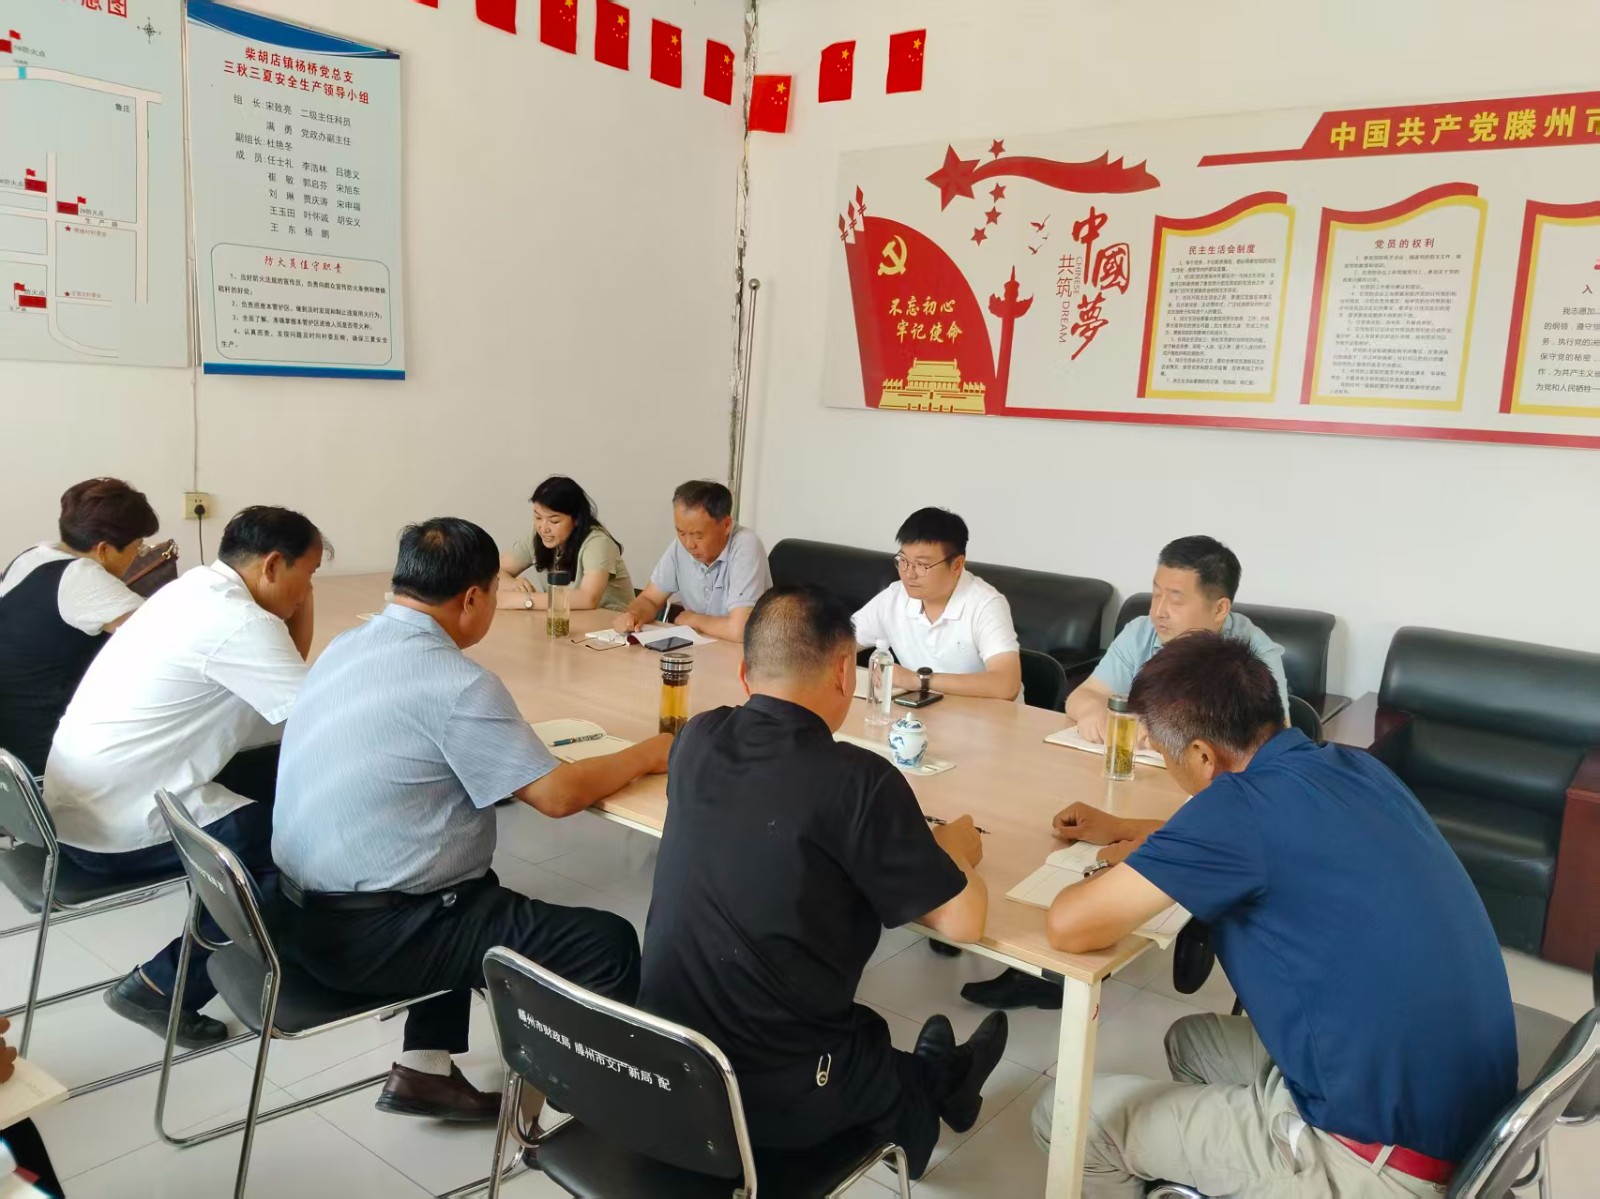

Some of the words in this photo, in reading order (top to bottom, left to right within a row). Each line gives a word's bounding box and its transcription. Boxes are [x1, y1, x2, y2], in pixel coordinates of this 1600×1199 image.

[245, 47, 354, 84] 柴胡店镇杨桥党总支
[223, 60, 370, 105] 三秋三夏安全生产领导小组
[300, 109, 351, 126] 二级主任科员
[301, 128, 351, 146] 党政办副主任
[302, 161, 327, 174] 李浩林
[336, 167, 360, 180] 吕德义
[336, 184, 361, 196] 宋旭东
[269, 206, 296, 218] 王玉田
[337, 215, 361, 227] 胡安义
[1188, 244, 1255, 255] 民主生活会制度
[1375, 238, 1435, 249] 党员的权利
[264, 255, 342, 274] 防火员值守职责
[1055, 253, 1075, 298] 共筑
[1072, 256, 1083, 295] CHINESE
[888, 295, 956, 317] 不忘初心
[1562, 307, 1600, 316] 我志愿加
[896, 320, 963, 344] 牢记使命
[1058, 301, 1070, 343] DREAM
